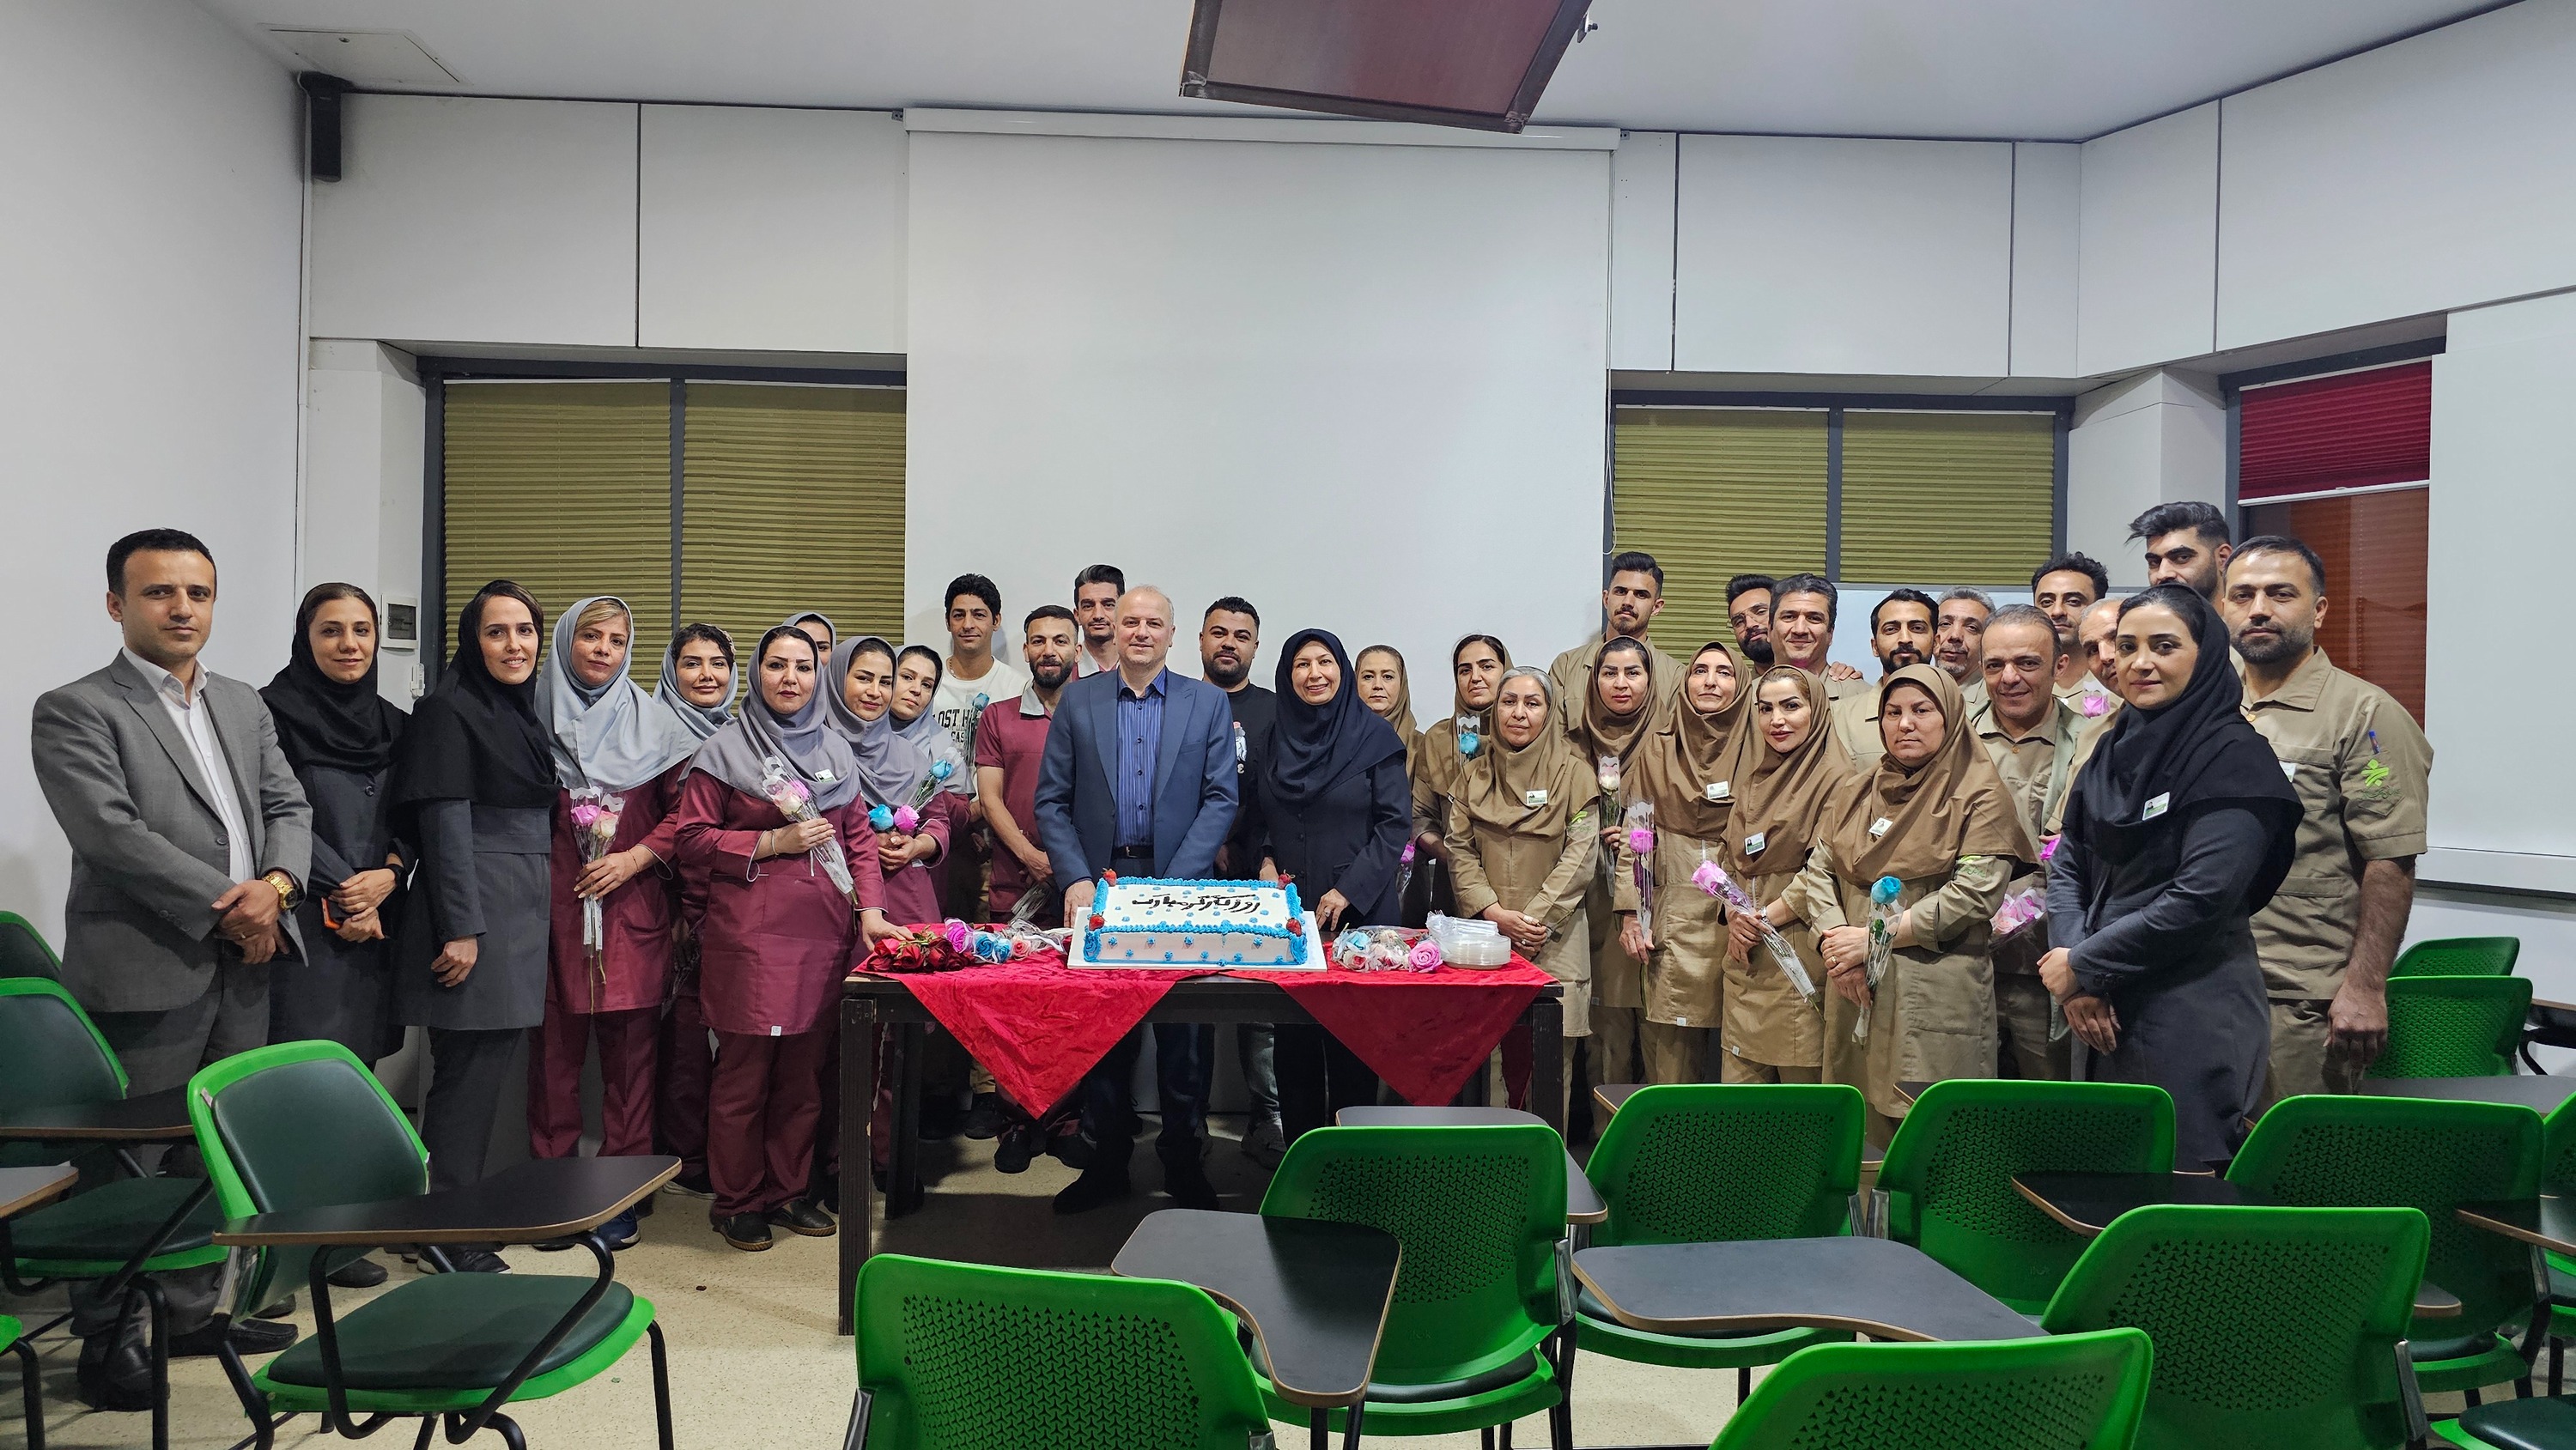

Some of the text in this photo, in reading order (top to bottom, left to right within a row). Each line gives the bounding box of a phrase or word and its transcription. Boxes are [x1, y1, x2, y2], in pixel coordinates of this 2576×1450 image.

[933, 709, 960, 727] OST
[951, 731, 964, 743] CAS
[1132, 894, 1188, 909] مبارک
[1224, 898, 1261, 914] روز
